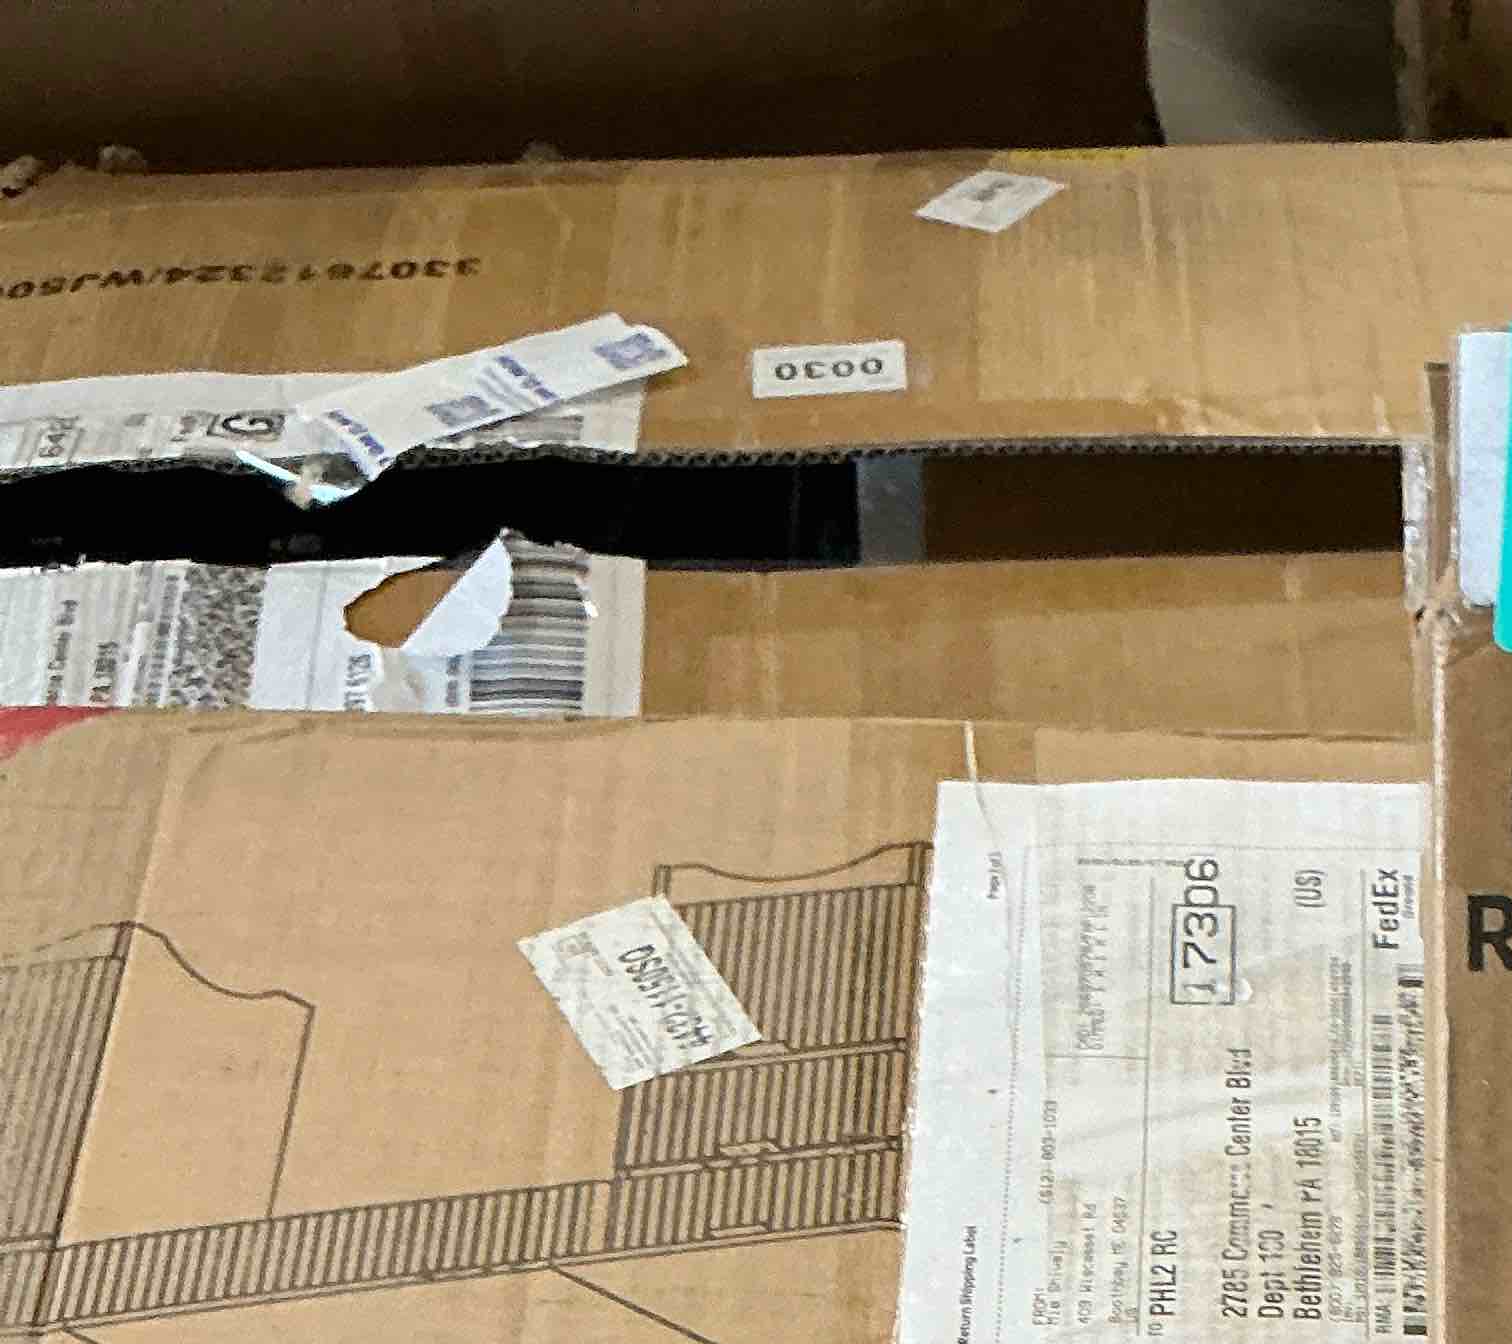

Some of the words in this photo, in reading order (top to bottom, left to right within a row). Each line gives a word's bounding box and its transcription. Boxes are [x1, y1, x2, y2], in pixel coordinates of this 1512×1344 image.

[1292, 868, 1326, 909] (US)
[1371, 868, 1399, 950] FedEx
[1224, 1047, 1252, 1089] Blvd
[1224, 1096, 1251, 1157] Center
[1293, 1117, 1323, 1168] 18015
[1295, 1178, 1323, 1203] PA
[1149, 1230, 1177, 1256] RC
[1293, 1211, 1323, 1321] Bethlehem
[1149, 1264, 1177, 1317] PHL2
[1221, 1268, 1250, 1320] 2785
[1257, 1271, 1288, 1320] Dept
[956, 1307, 971, 1344] Return
